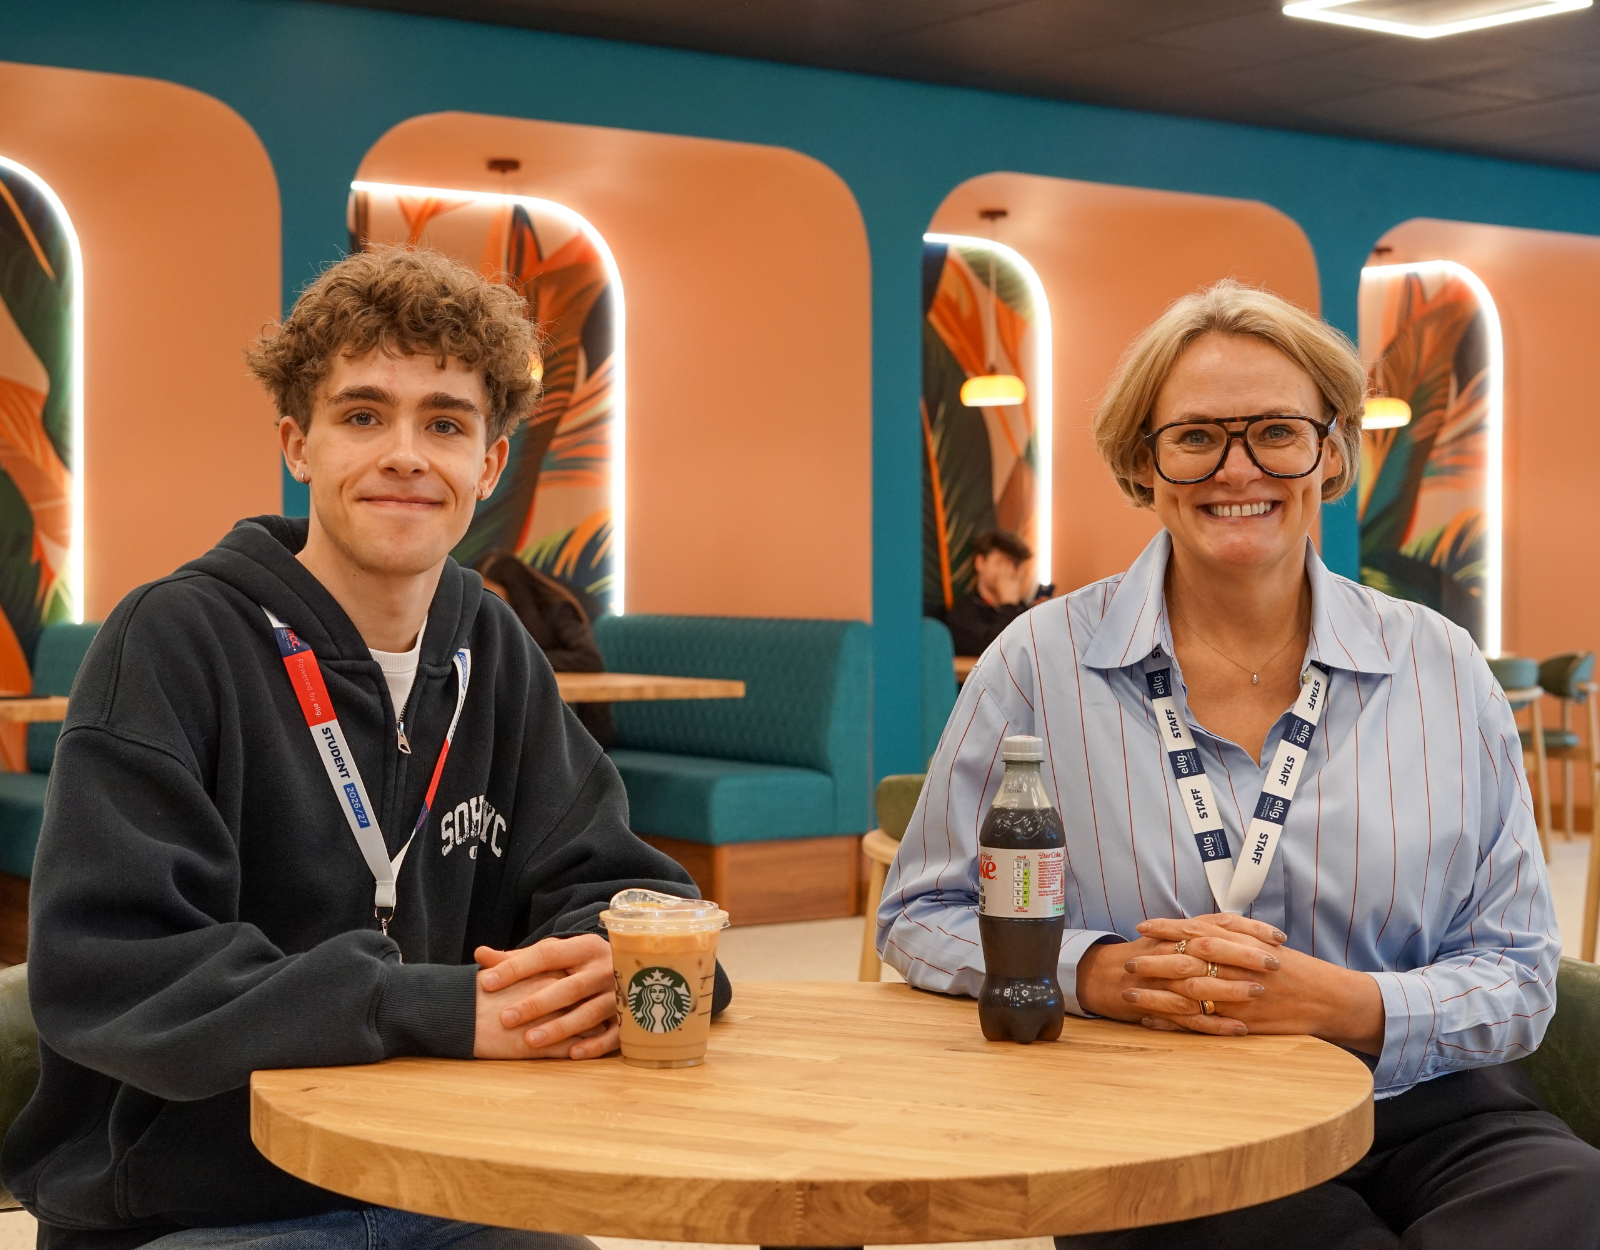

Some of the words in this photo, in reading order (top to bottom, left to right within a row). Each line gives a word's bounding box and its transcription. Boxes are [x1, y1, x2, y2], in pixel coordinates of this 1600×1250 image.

[296, 658, 314, 691] Powered
[1307, 680, 1320, 710] STAFF
[1165, 708, 1182, 738] STAFF
[1296, 724, 1310, 744] ellg.
[321, 727, 350, 779] STUDENT
[347, 786, 368, 825] 2026/27
[1176, 752, 1188, 774] ellg.
[1280, 755, 1296, 786] STAFF
[1191, 788, 1208, 820] STAFF
[1269, 800, 1284, 820] ellg.
[1038, 852, 1050, 860] Diet
[1202, 834, 1214, 858] ellg.
[1252, 832, 1269, 866] STAFF
